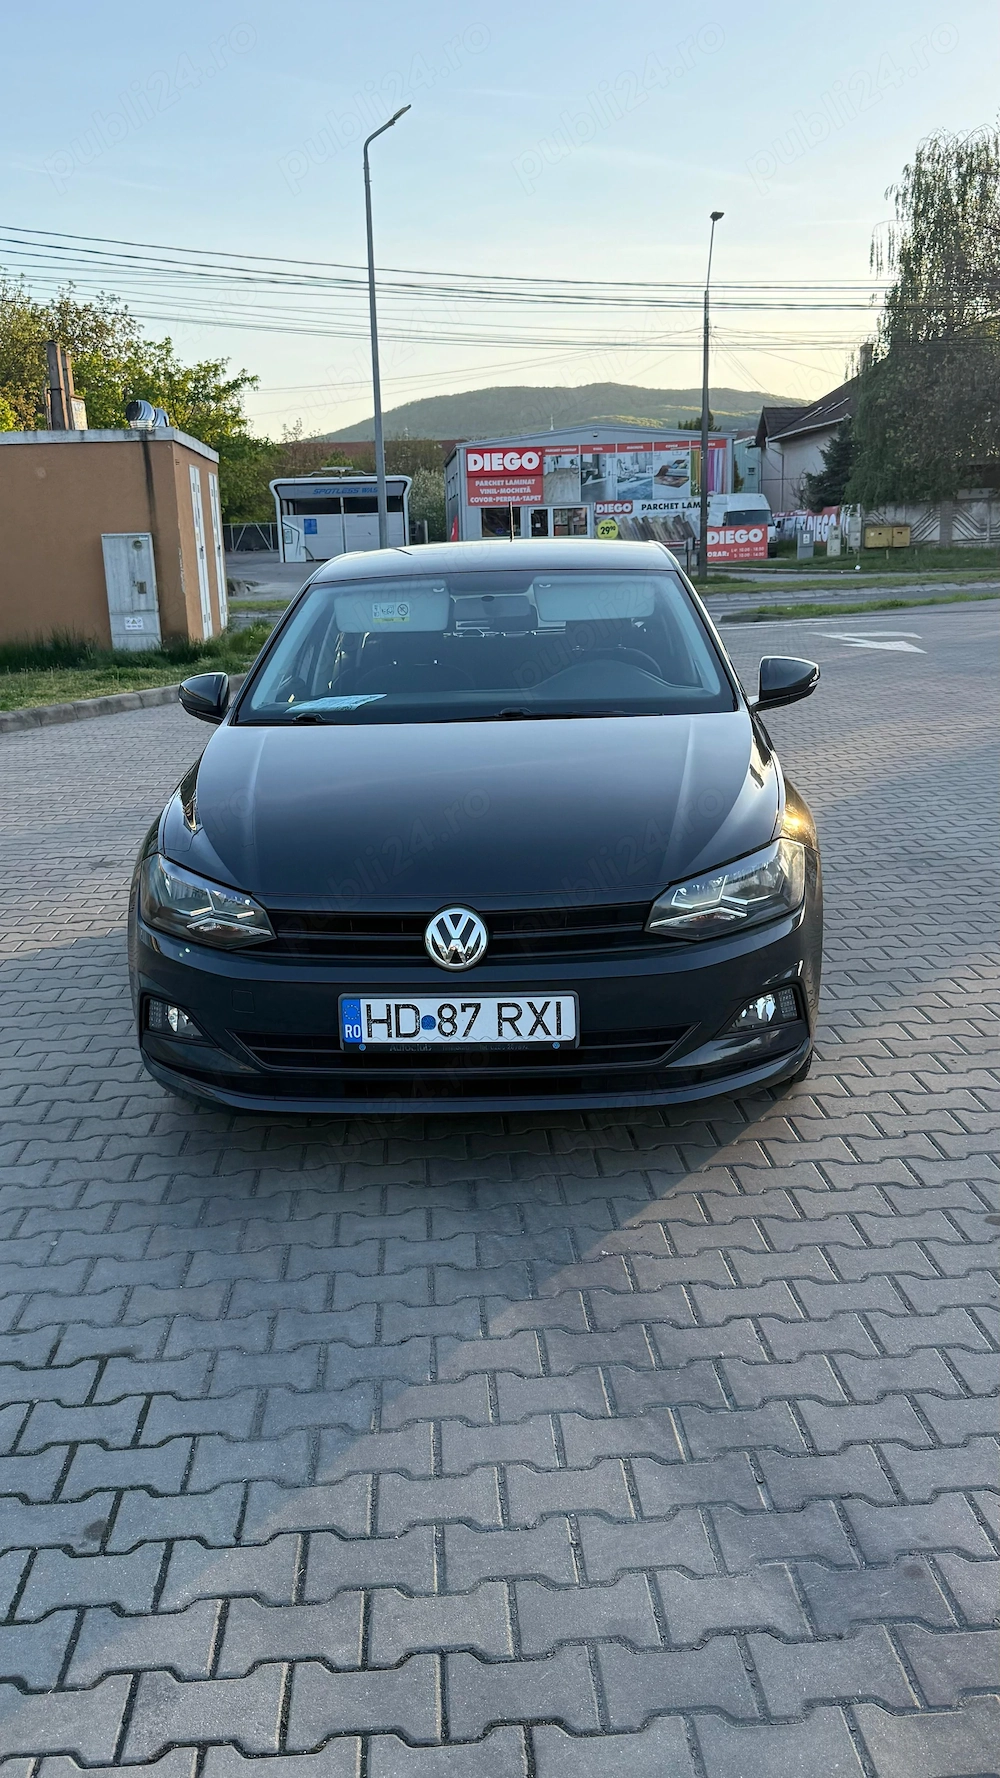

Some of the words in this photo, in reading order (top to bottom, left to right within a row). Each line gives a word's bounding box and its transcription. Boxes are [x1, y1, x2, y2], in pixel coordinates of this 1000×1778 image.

[467, 451, 540, 472] DIEGO
[475, 479, 505, 487] PARCHET
[505, 478, 536, 486] LAMINAT
[596, 503, 632, 513] DIEGO
[641, 502, 679, 511] PARCHET
[707, 528, 763, 545] DIEGO
[365, 1003, 421, 1038] HD
[437, 1002, 482, 1037] 87
[497, 1001, 562, 1037] RXI
[345, 1024, 361, 1039] RO
